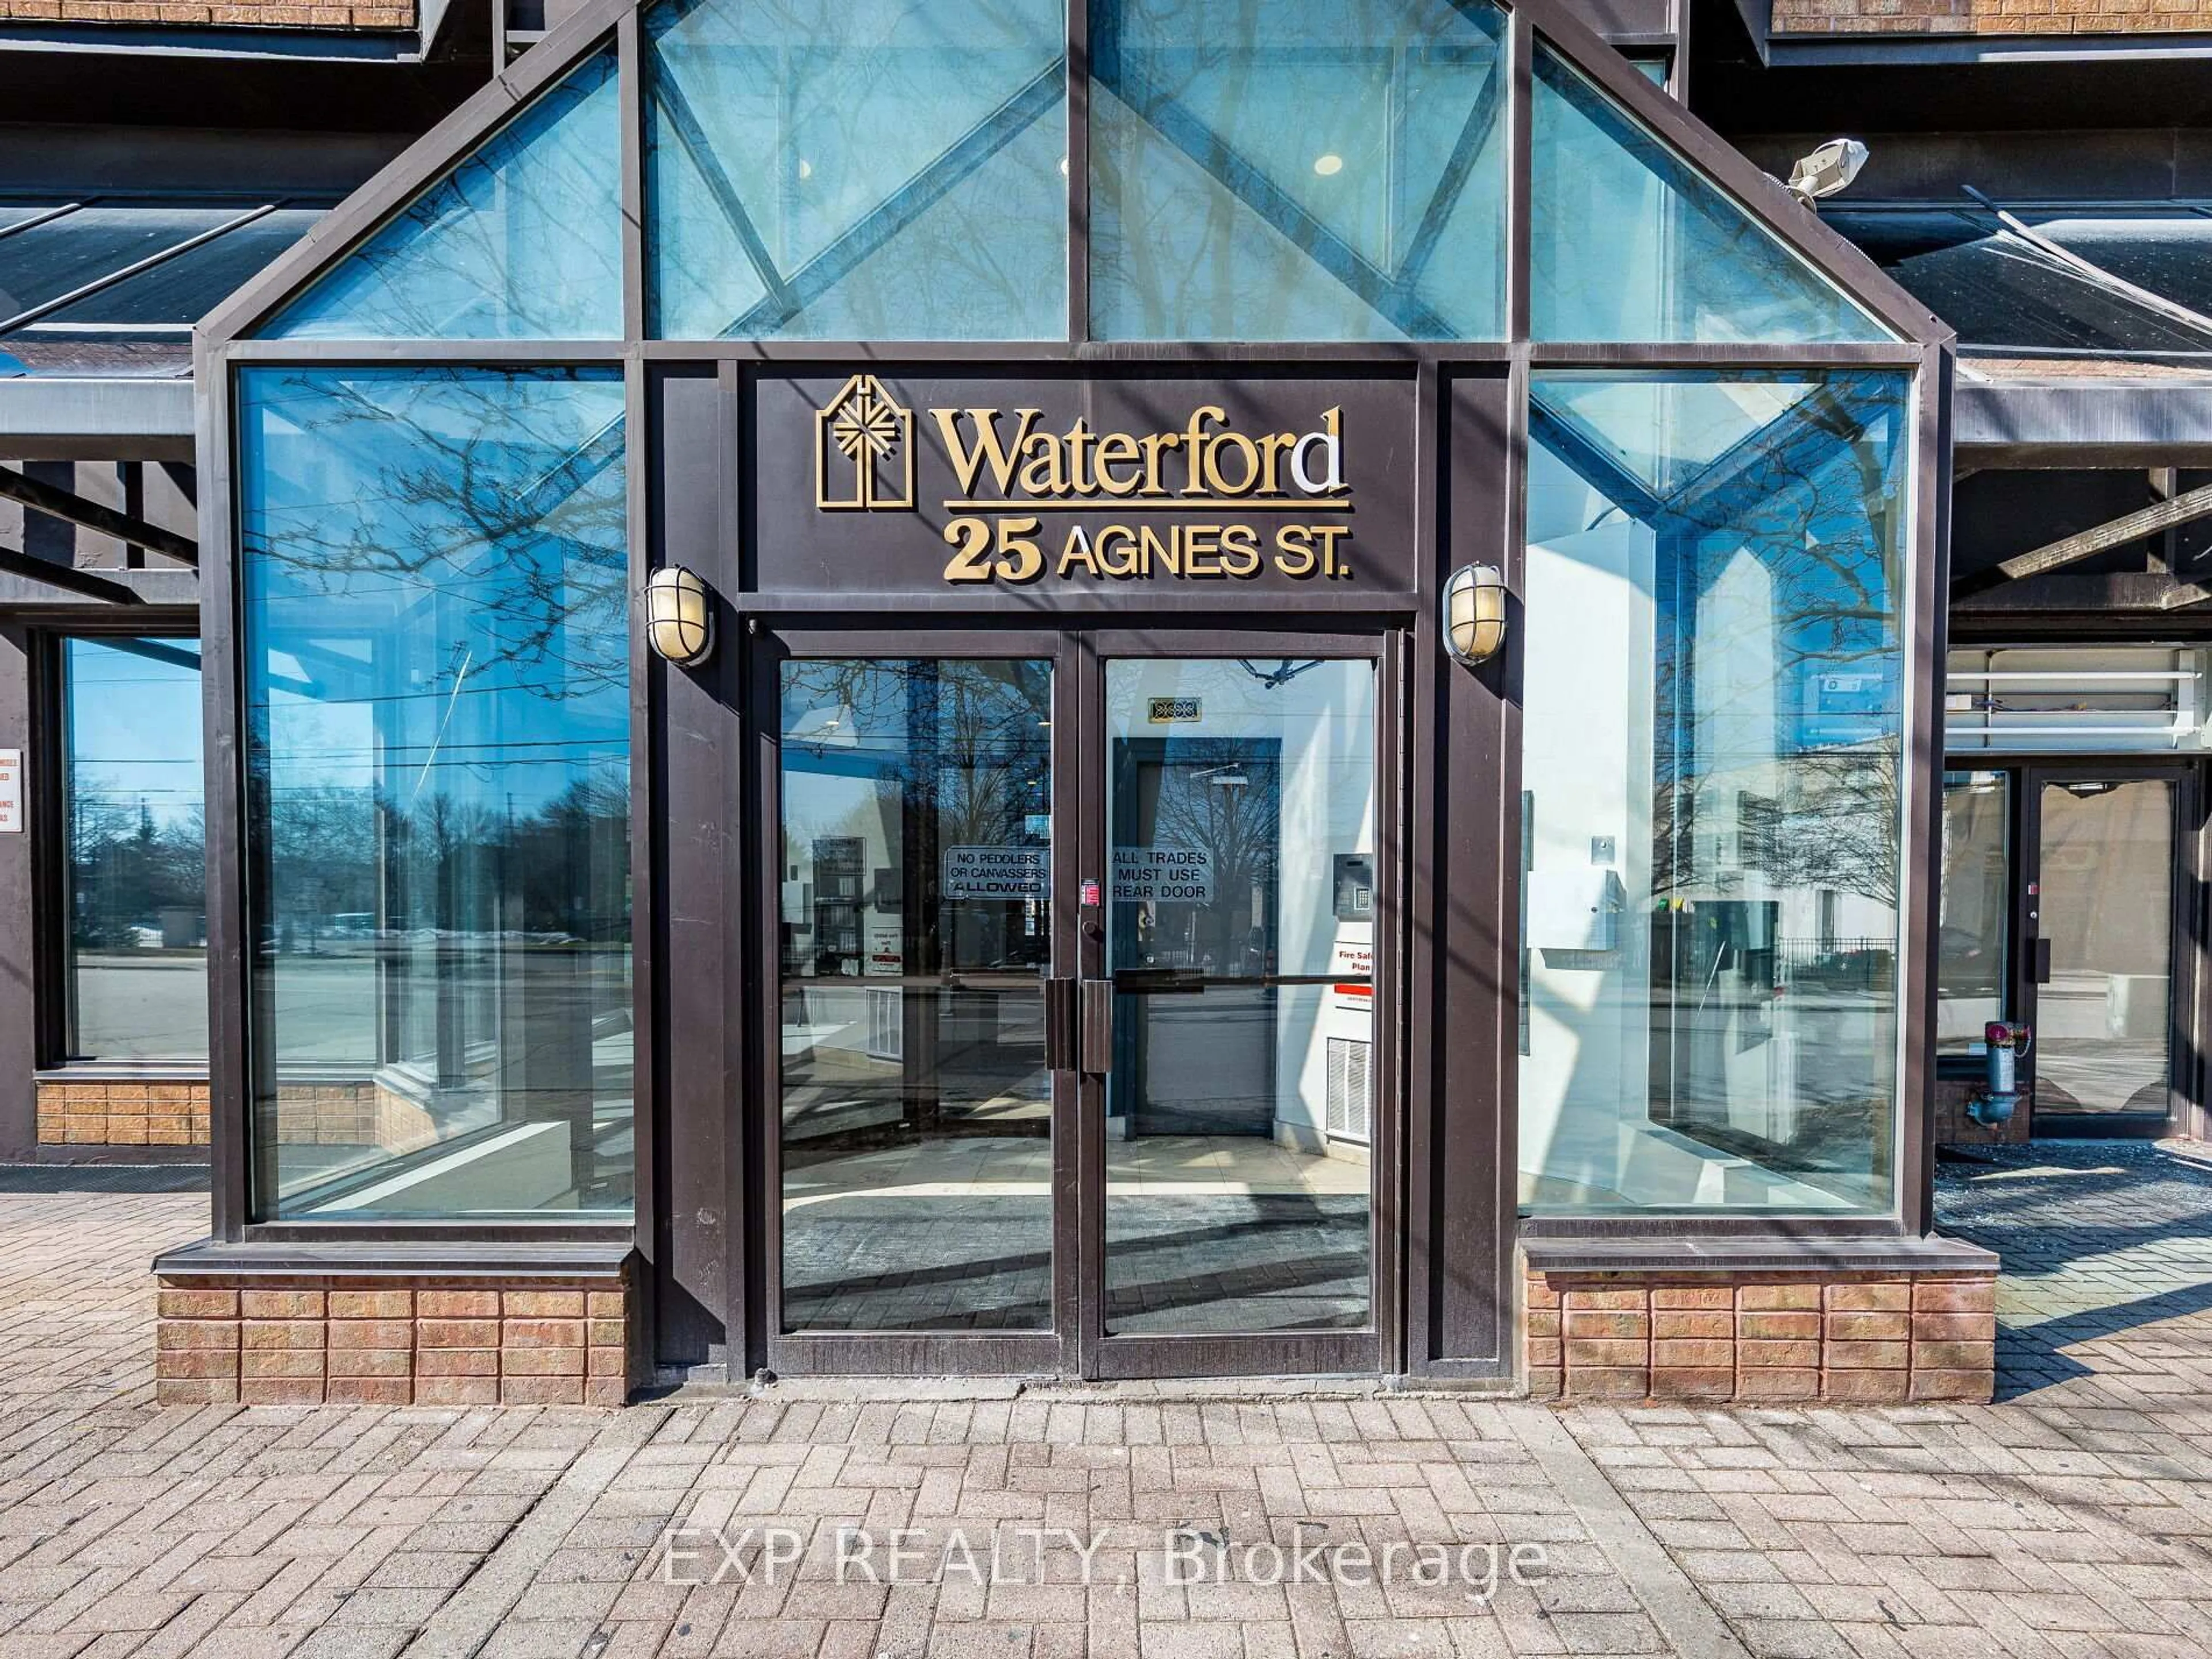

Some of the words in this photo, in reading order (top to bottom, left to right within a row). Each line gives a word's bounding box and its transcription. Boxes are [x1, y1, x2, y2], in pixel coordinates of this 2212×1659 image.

[928, 405, 1350, 494] Waterford
[943, 517, 1044, 581] 25
[1056, 525, 1260, 576] AGNES
[1274, 525, 1352, 575] ST.
[957, 854, 975, 863] NO
[979, 854, 1040, 864] PEDDLERS
[1112, 852, 1139, 863] ALL
[1146, 852, 1207, 864] TRADES
[950, 868, 967, 878] OR
[971, 868, 1046, 879] CANVASSERS
[1119, 869, 1161, 881] MUST
[1169, 869, 1200, 881] USE
[953, 882, 1042, 892] ALLOWED
[1112, 886, 1153, 897] REAR
[1161, 886, 1206, 897] DOOR
[1339, 950, 1355, 959] Fire
[1352, 963, 1370, 971] Plan
